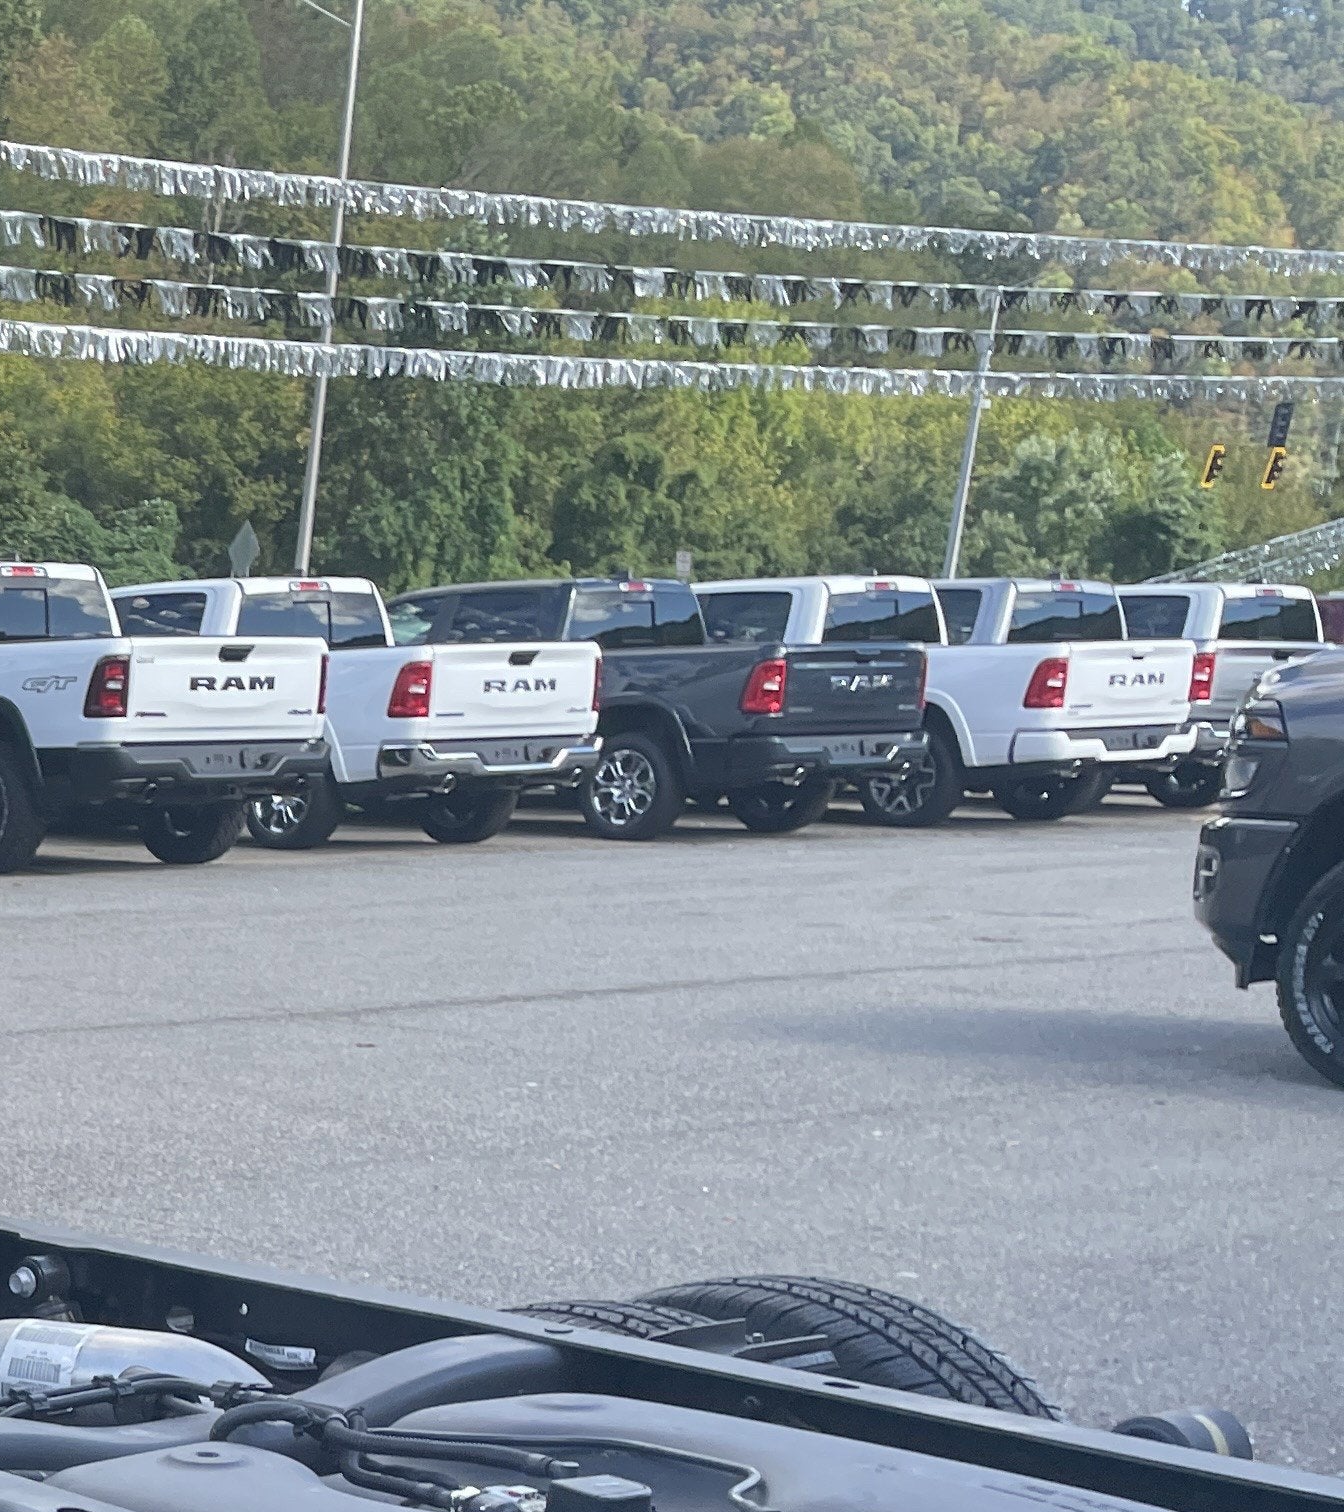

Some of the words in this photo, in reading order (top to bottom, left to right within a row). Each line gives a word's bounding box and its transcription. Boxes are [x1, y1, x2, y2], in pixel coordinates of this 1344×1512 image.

[188, 676, 276, 691] RAM
[483, 678, 557, 692] RAM
[1108, 673, 1165, 686] RAM
